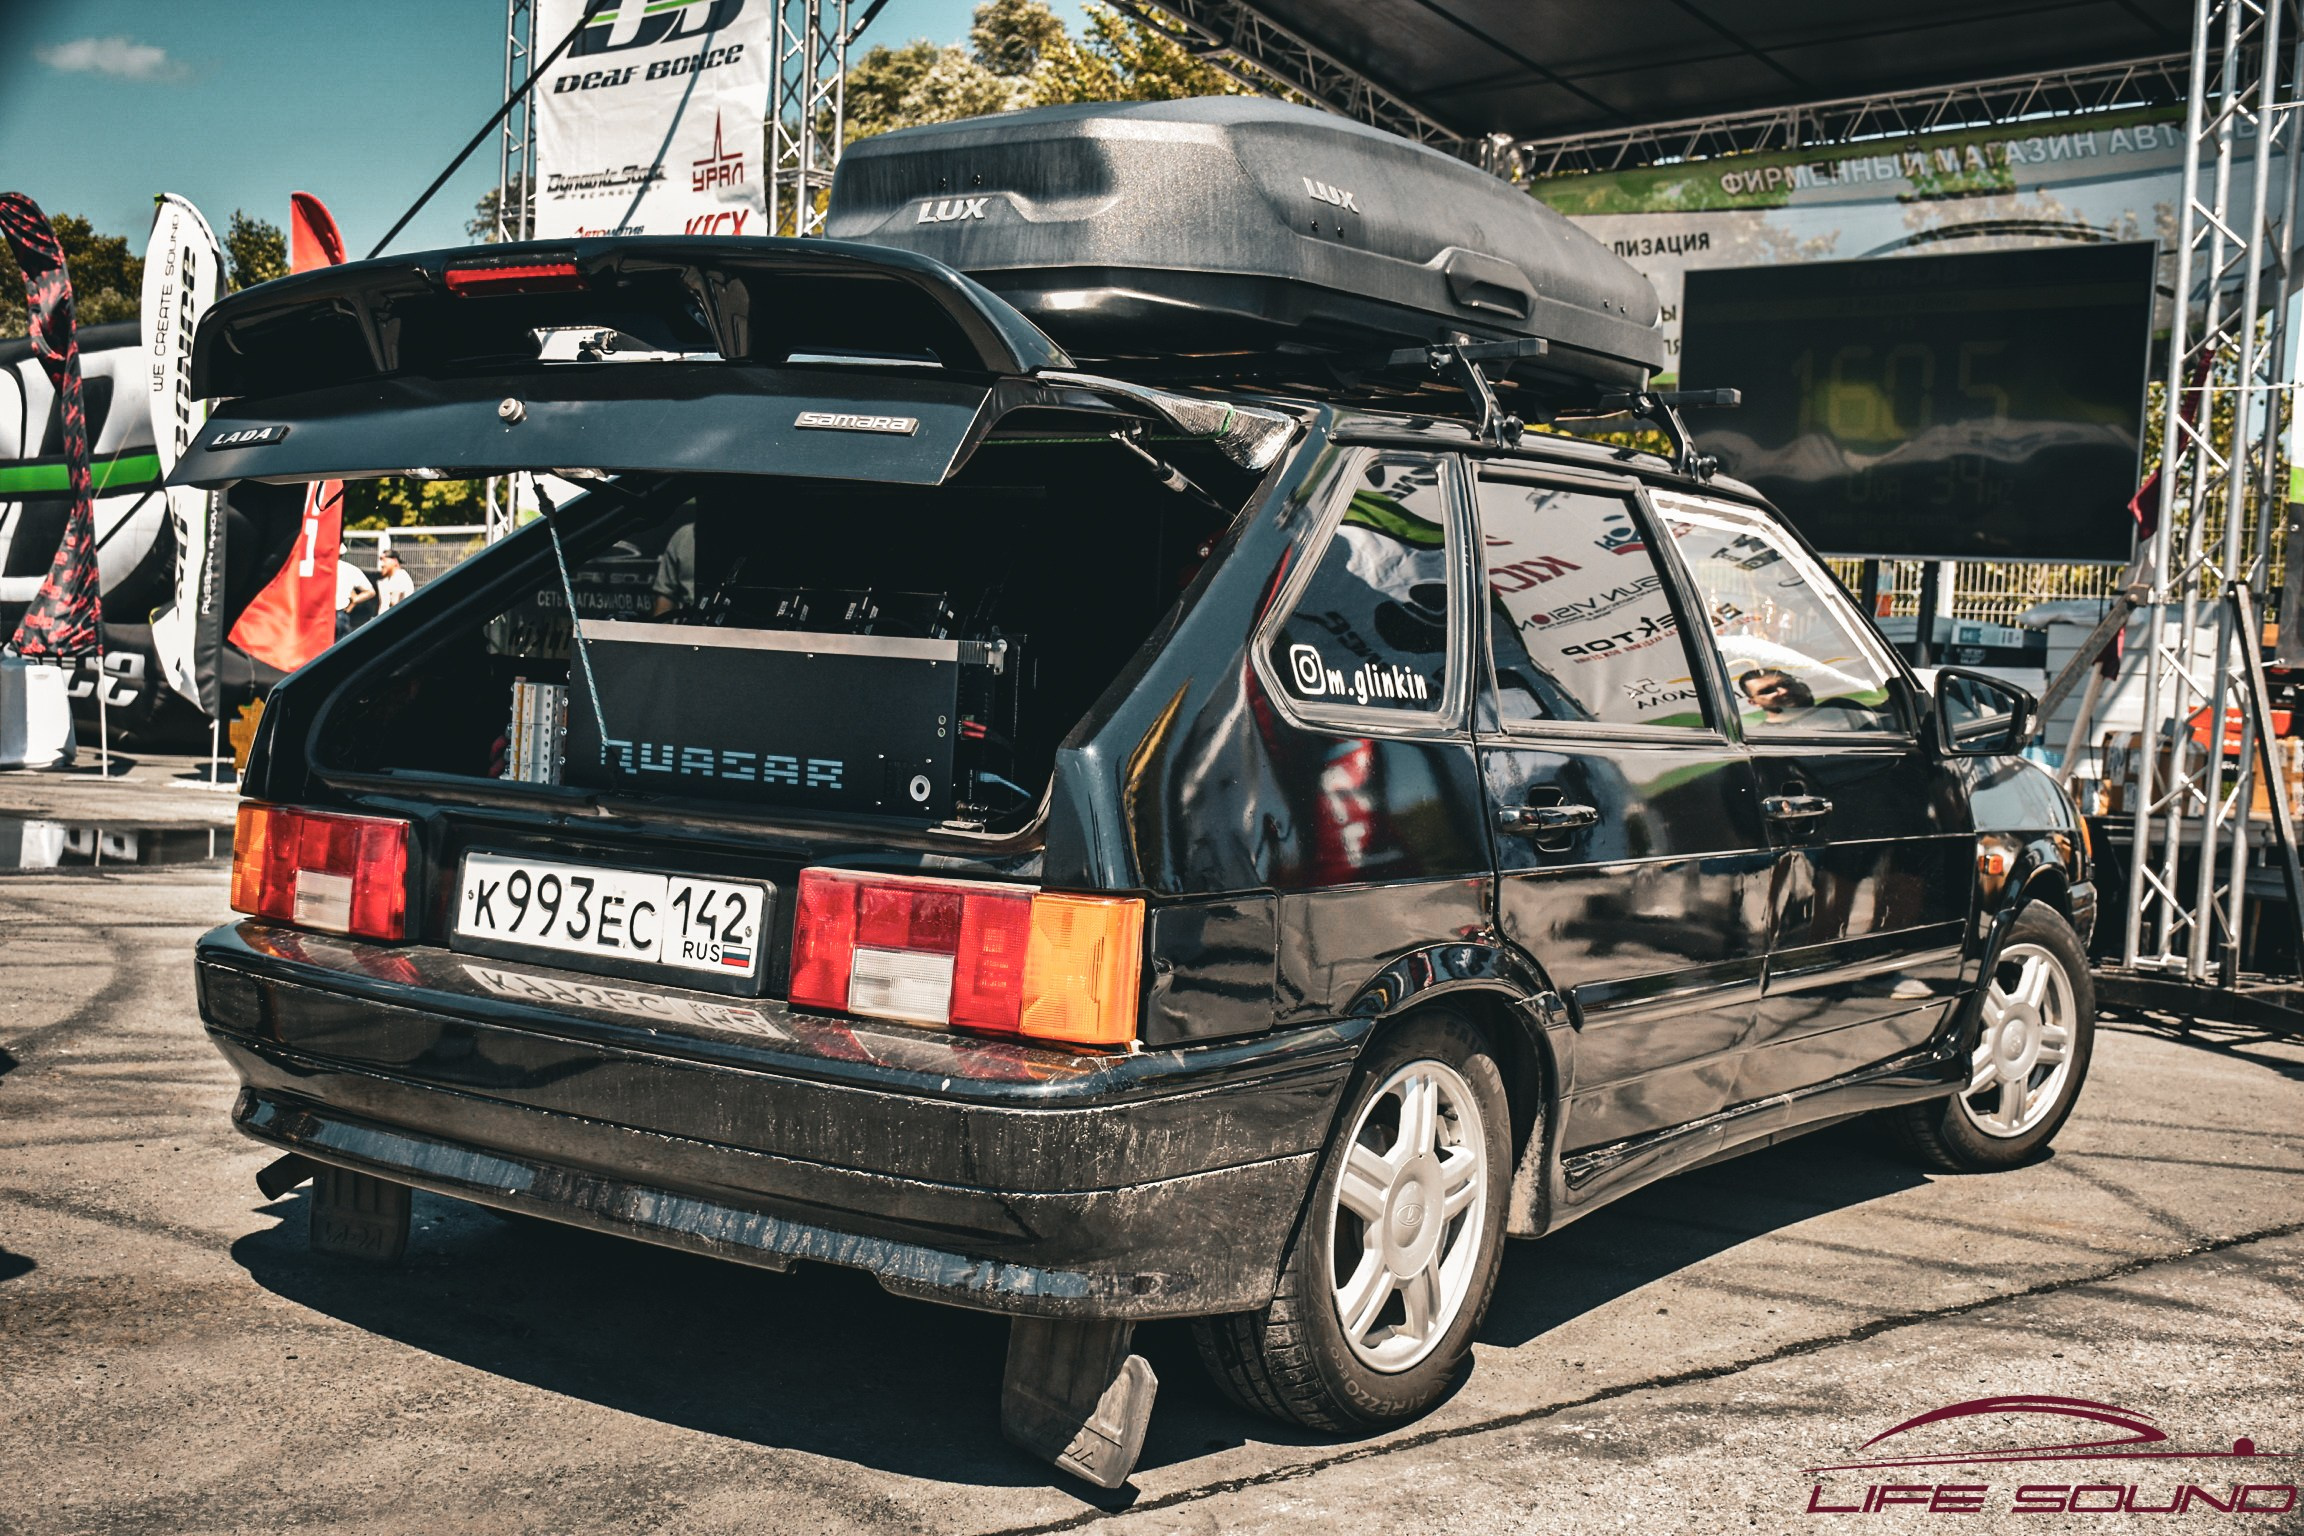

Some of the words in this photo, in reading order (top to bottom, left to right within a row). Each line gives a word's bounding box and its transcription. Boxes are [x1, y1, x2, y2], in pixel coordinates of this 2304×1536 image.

[1720, 145, 1926, 195] ФИРМЕННЫЙ
[1935, 129, 2098, 175] МАГАЗИН
[916, 198, 989, 225] LUX
[1303, 176, 1360, 214] LUX
[164, 213, 181, 276] SOUND
[1602, 231, 1711, 259] ЛИЗАЦИЯ
[154, 283, 173, 357] CREATE
[153, 364, 165, 393] WE
[211, 427, 273, 446] LADA
[537, 589, 564, 608] СЕТЬ
[1326, 662, 1428, 706] m.glinkin
[600, 739, 844, 790] QUASAR
[473, 868, 657, 951] К993ЕС
[672, 885, 748, 945] 142
[682, 940, 721, 963] RUS
